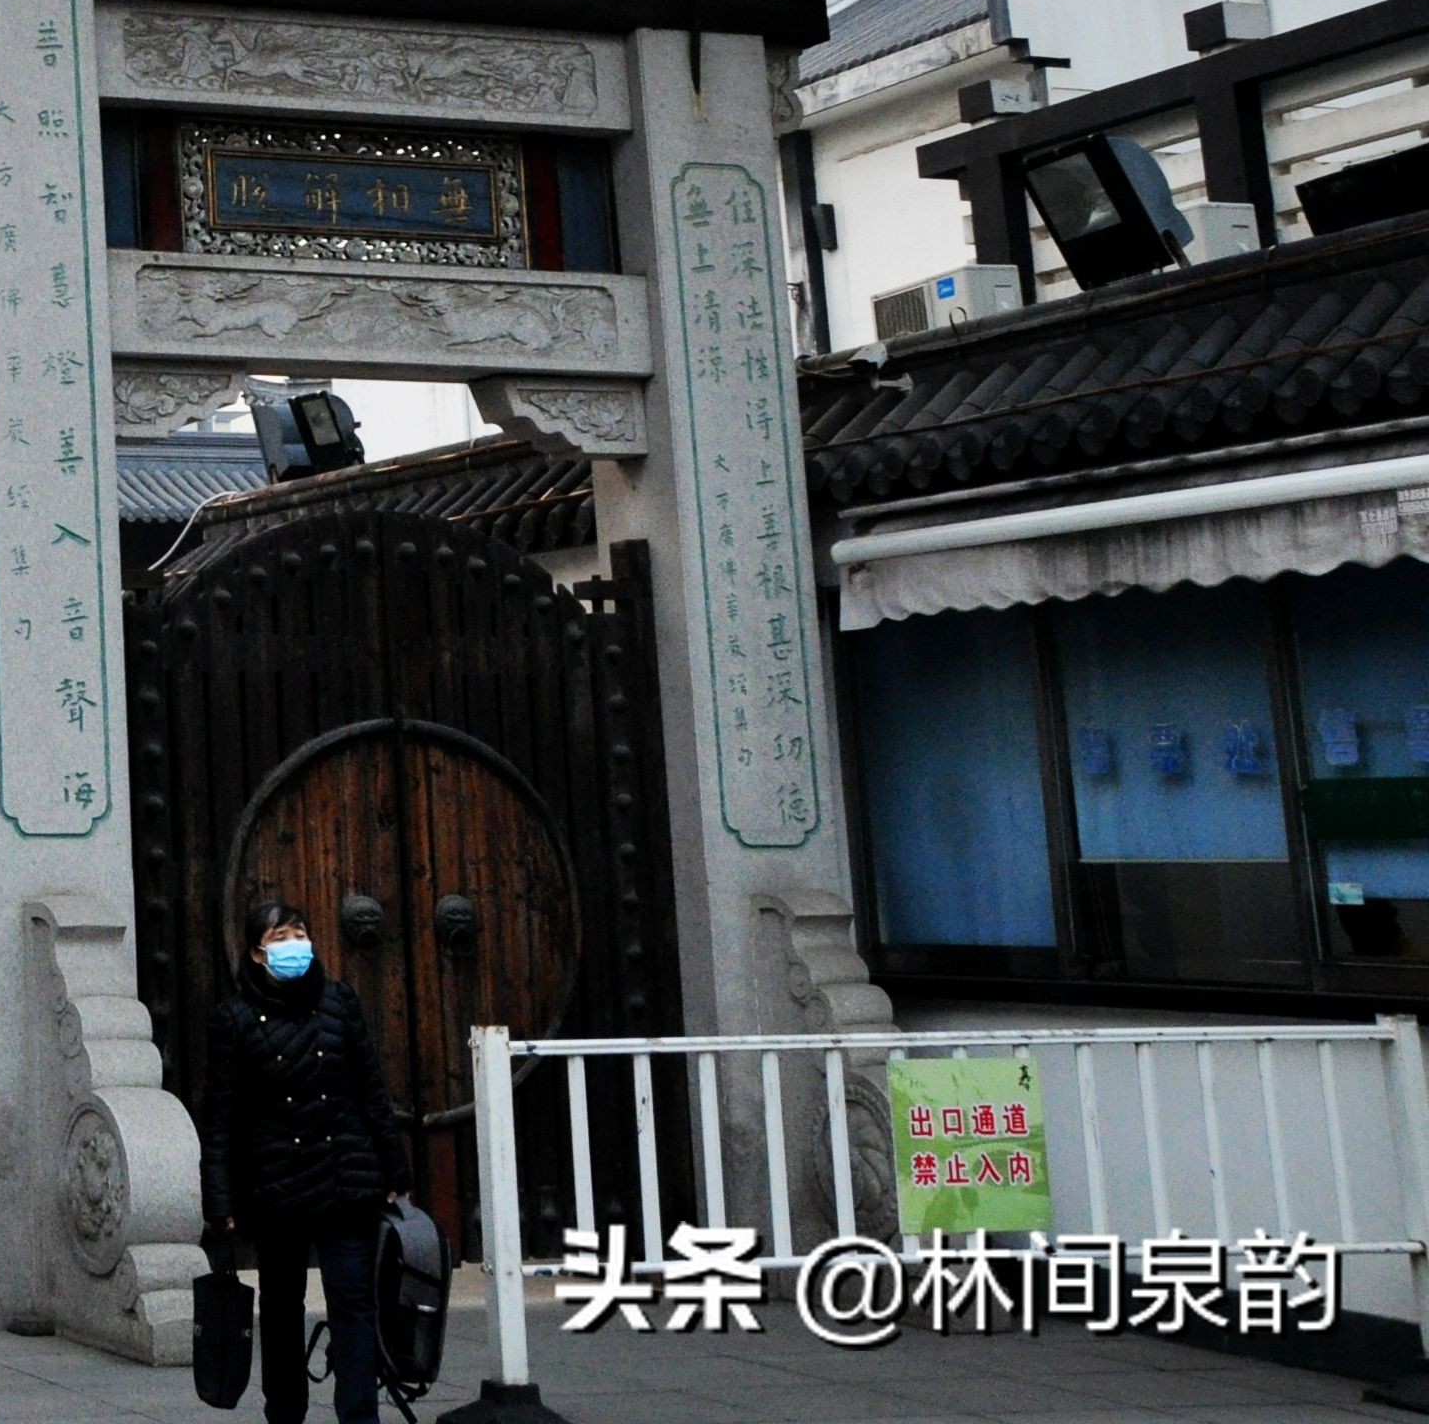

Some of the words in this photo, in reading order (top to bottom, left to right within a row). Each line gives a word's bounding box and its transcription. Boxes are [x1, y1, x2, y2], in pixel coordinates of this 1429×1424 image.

[910, 1103, 1029, 1137] 出口通道
[912, 1151, 1033, 1186] 禁止入内
